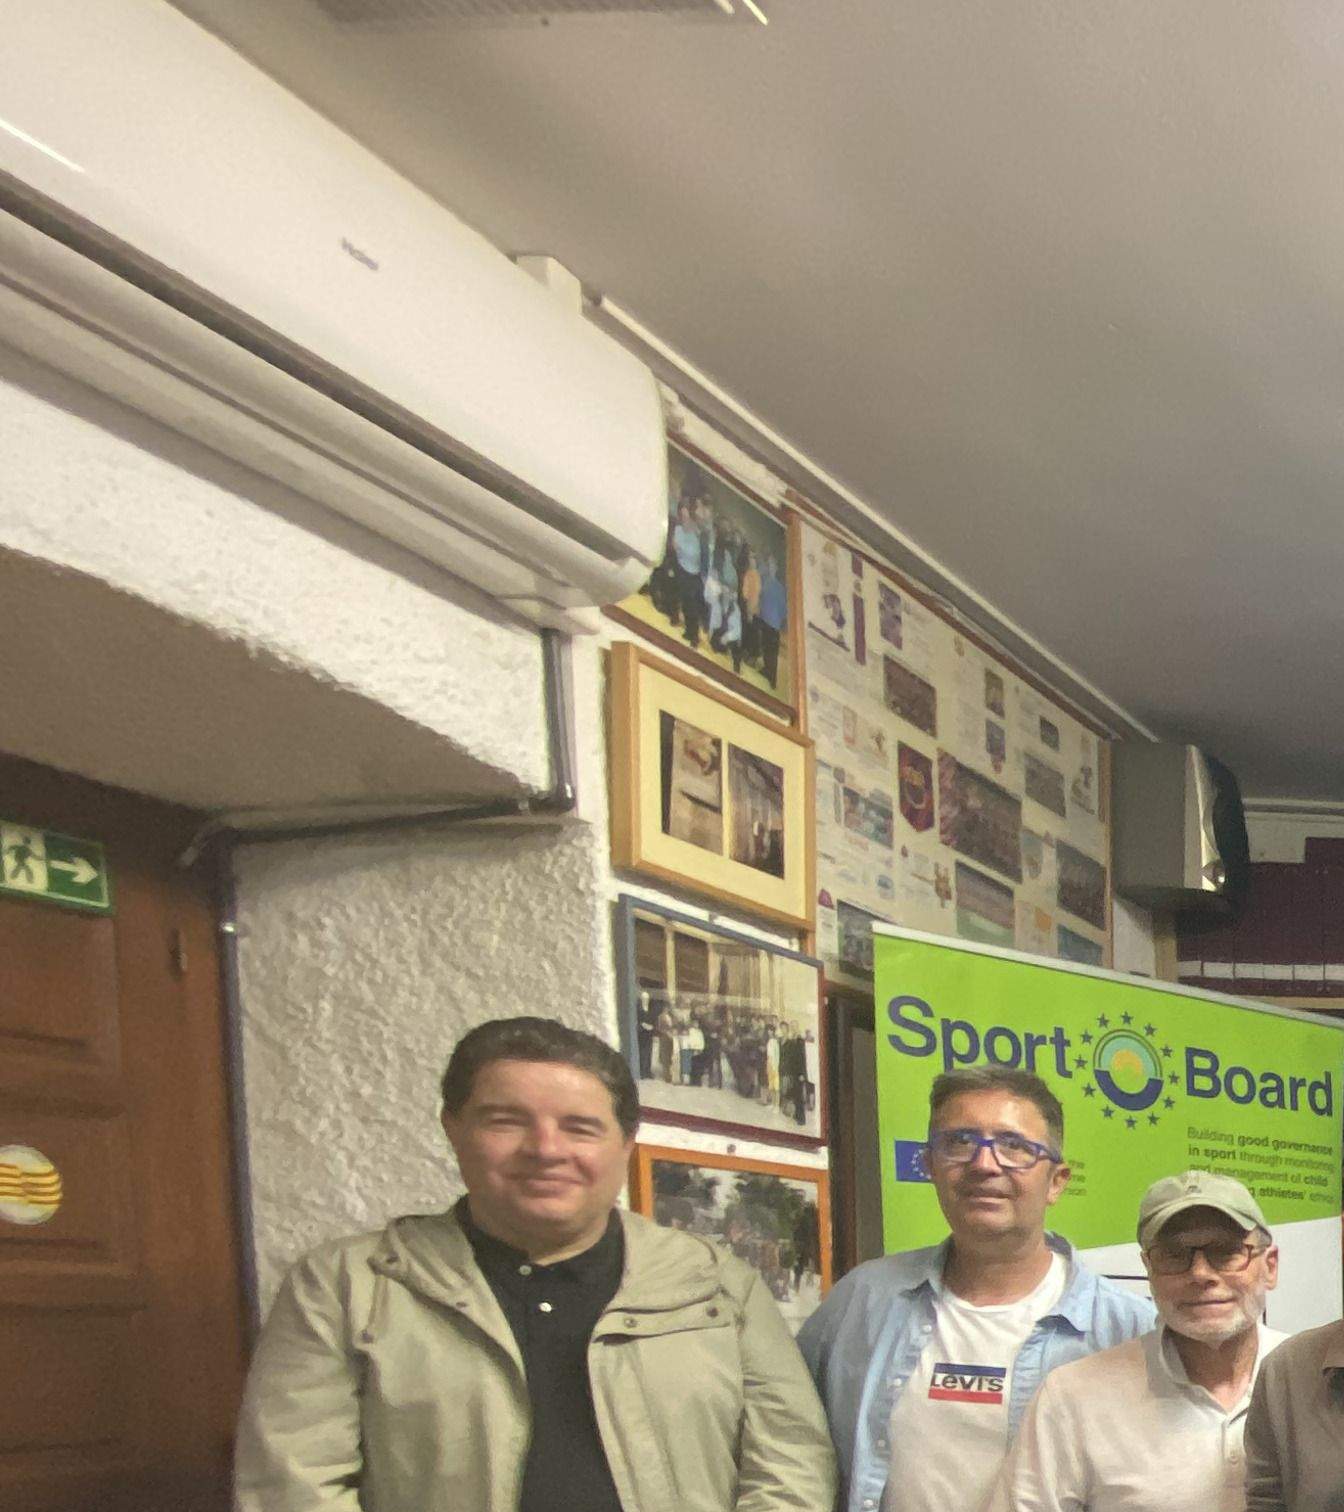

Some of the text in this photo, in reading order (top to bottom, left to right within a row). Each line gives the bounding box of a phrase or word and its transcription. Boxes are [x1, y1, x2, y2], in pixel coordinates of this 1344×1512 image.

[887, 995, 1334, 1117] Sport Board
[1237, 1135, 1269, 1147] good
[1188, 1144, 1200, 1156] in
[1204, 1149, 1236, 1160] sport
